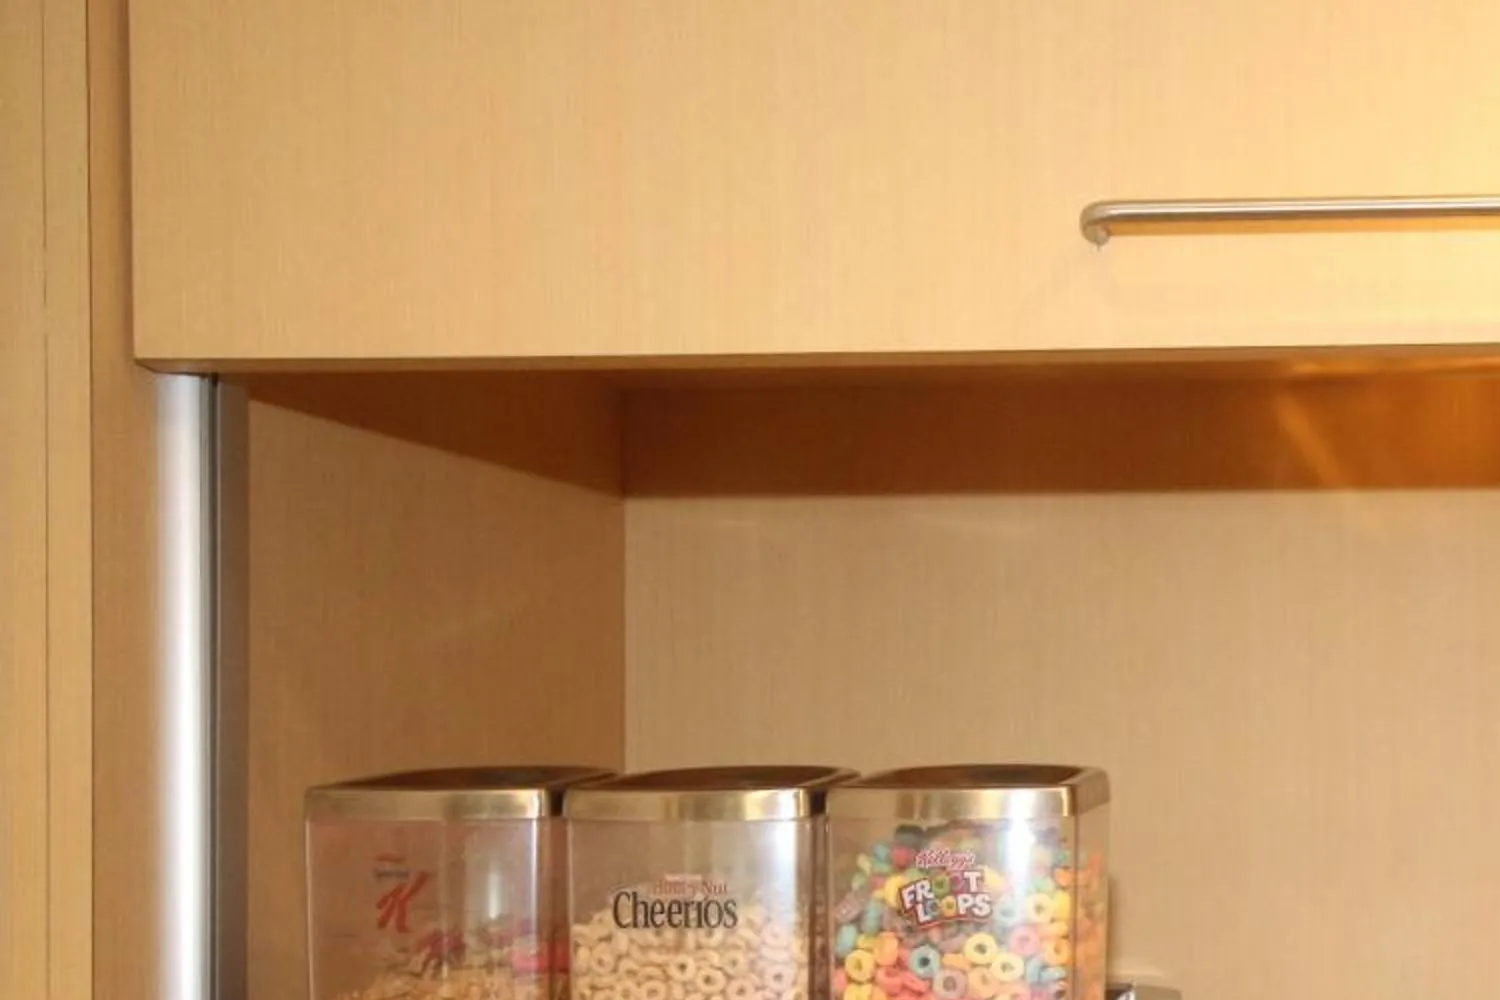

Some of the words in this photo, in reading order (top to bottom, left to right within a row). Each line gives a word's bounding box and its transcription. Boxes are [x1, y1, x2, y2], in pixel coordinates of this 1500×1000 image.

[902, 871, 981, 909] FROOT
[916, 893, 991, 923] LOOPS
[613, 891, 738, 929] Cheerios
